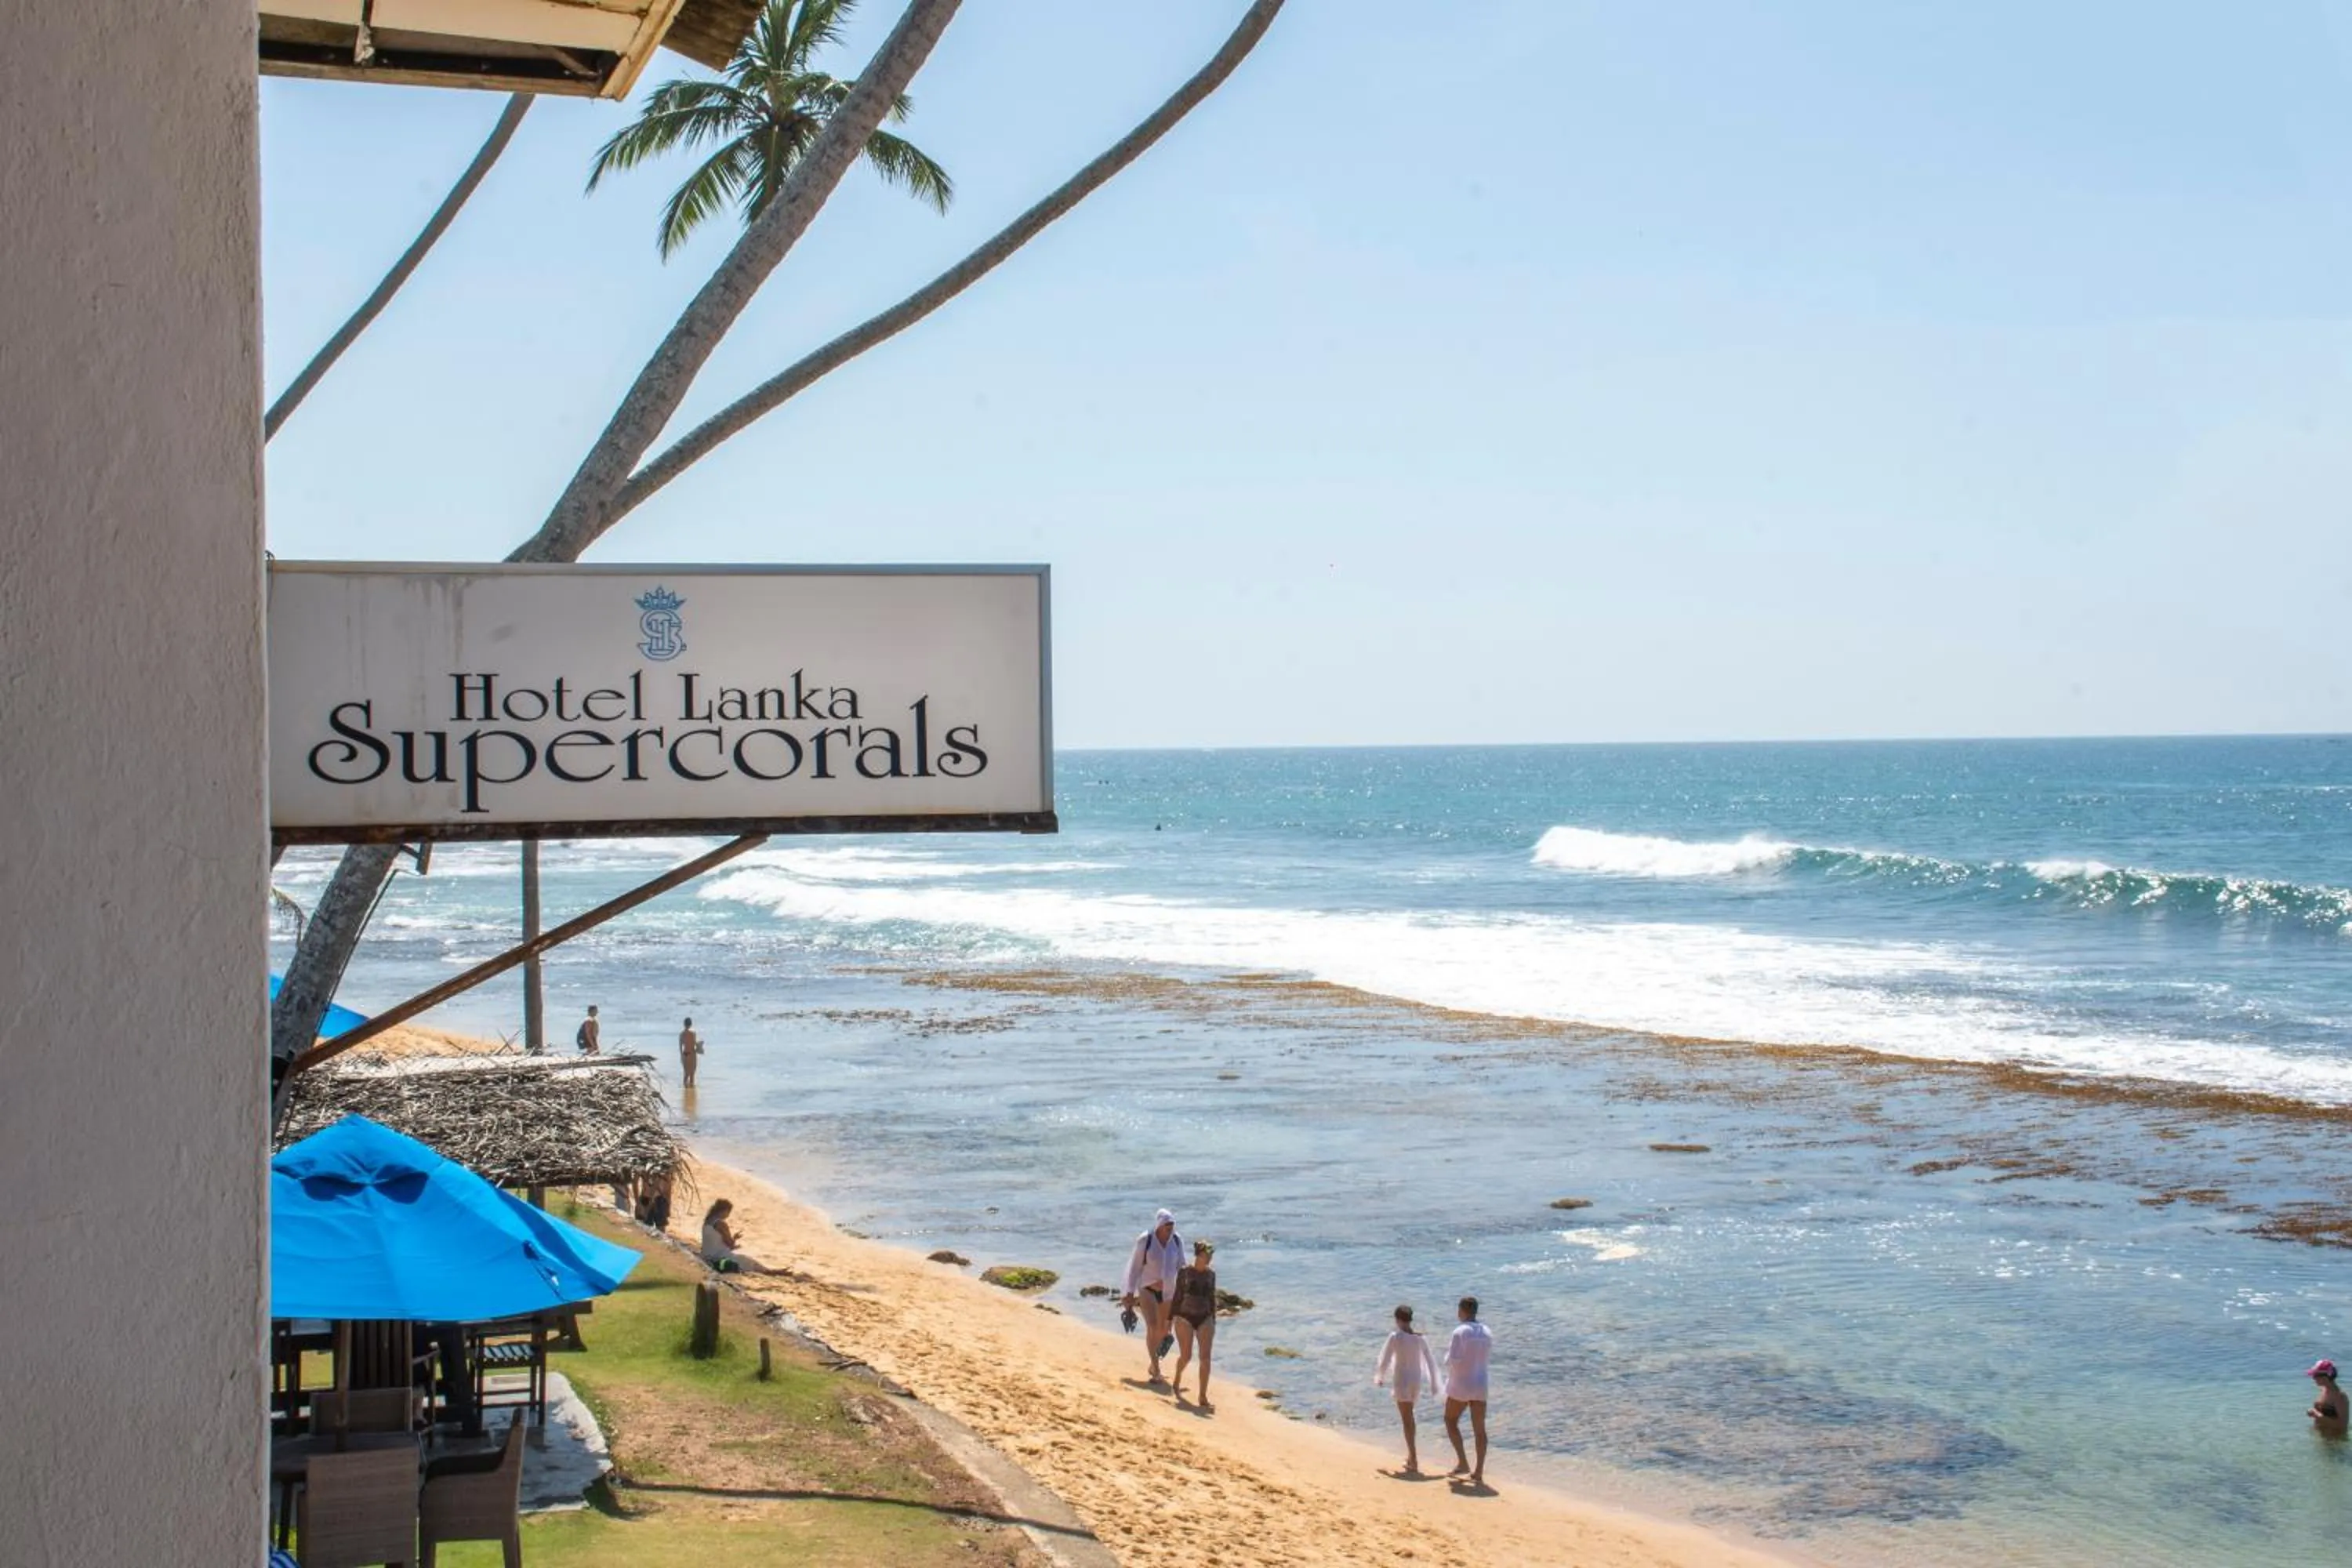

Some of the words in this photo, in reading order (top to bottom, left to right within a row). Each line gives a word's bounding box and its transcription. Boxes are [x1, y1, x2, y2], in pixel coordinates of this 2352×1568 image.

[448, 669, 647, 722] Hotel
[677, 668, 863, 724] Lanka
[306, 695, 989, 814] Supercorals
